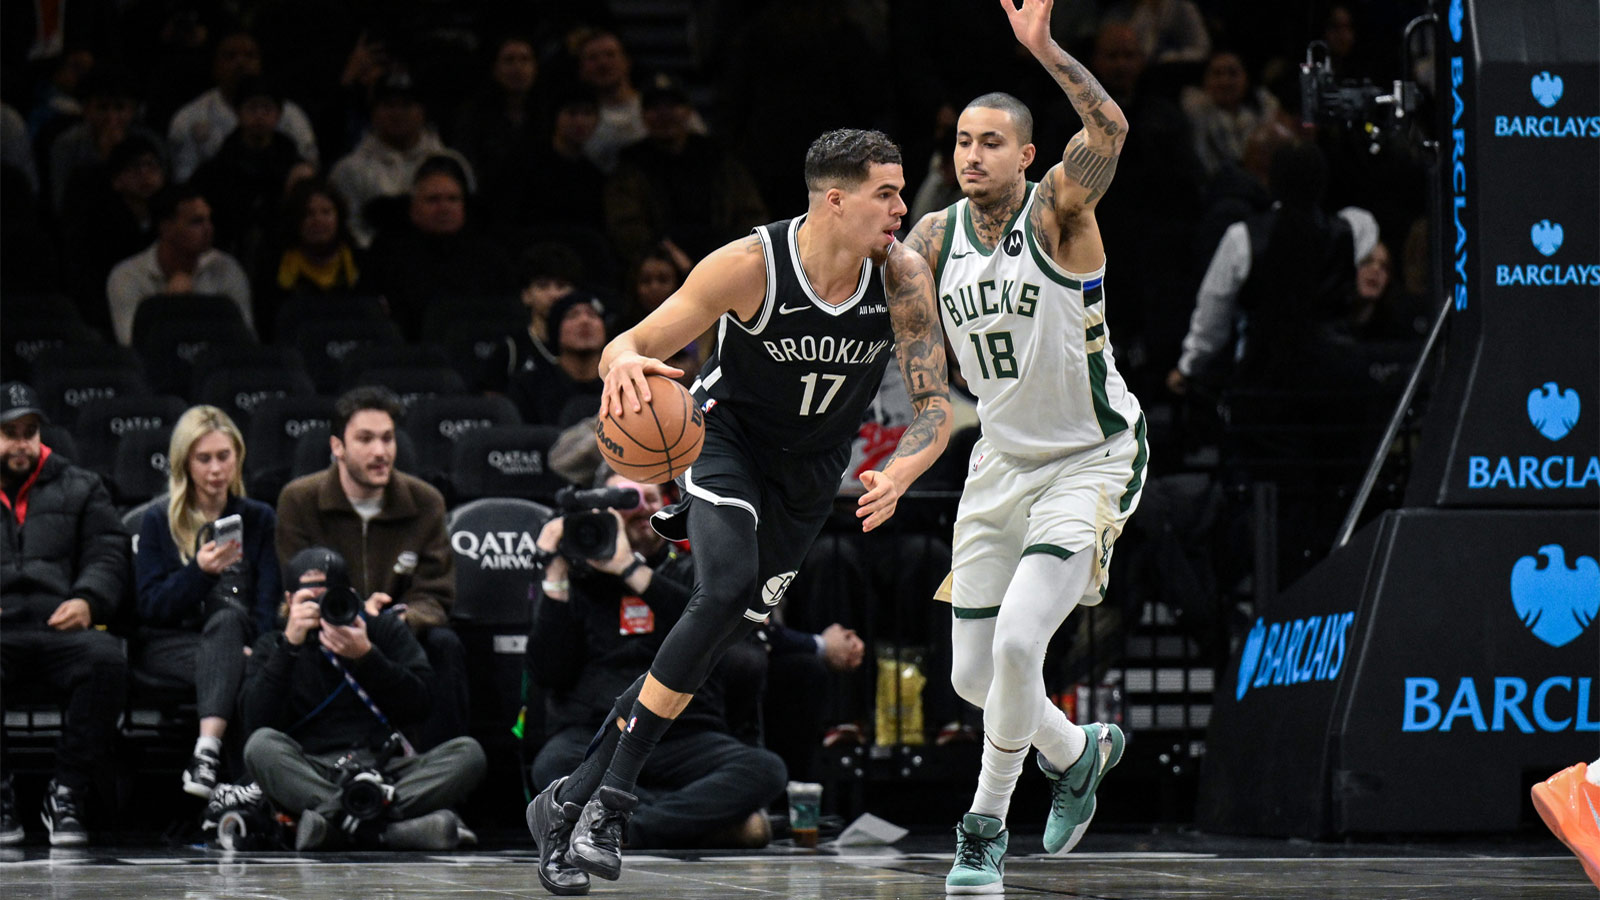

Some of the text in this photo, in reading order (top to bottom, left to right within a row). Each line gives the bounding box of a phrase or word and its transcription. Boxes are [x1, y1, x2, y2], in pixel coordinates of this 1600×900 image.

[1495, 116, 1600, 137] BARCLAYS
[1450, 57, 1468, 311] BARCLAYS
[1496, 265, 1600, 286] BARCLAYS
[860, 306, 868, 315] All
[869, 305, 876, 314] In
[942, 279, 1041, 328] BUCKS
[969, 331, 1019, 380] 18
[799, 372, 847, 416] 17
[1468, 456, 1600, 489] BARCLA
[451, 530, 538, 560] QATA
[1253, 611, 1355, 688] BARCLAYS
[1402, 676, 1600, 734] BARCL
